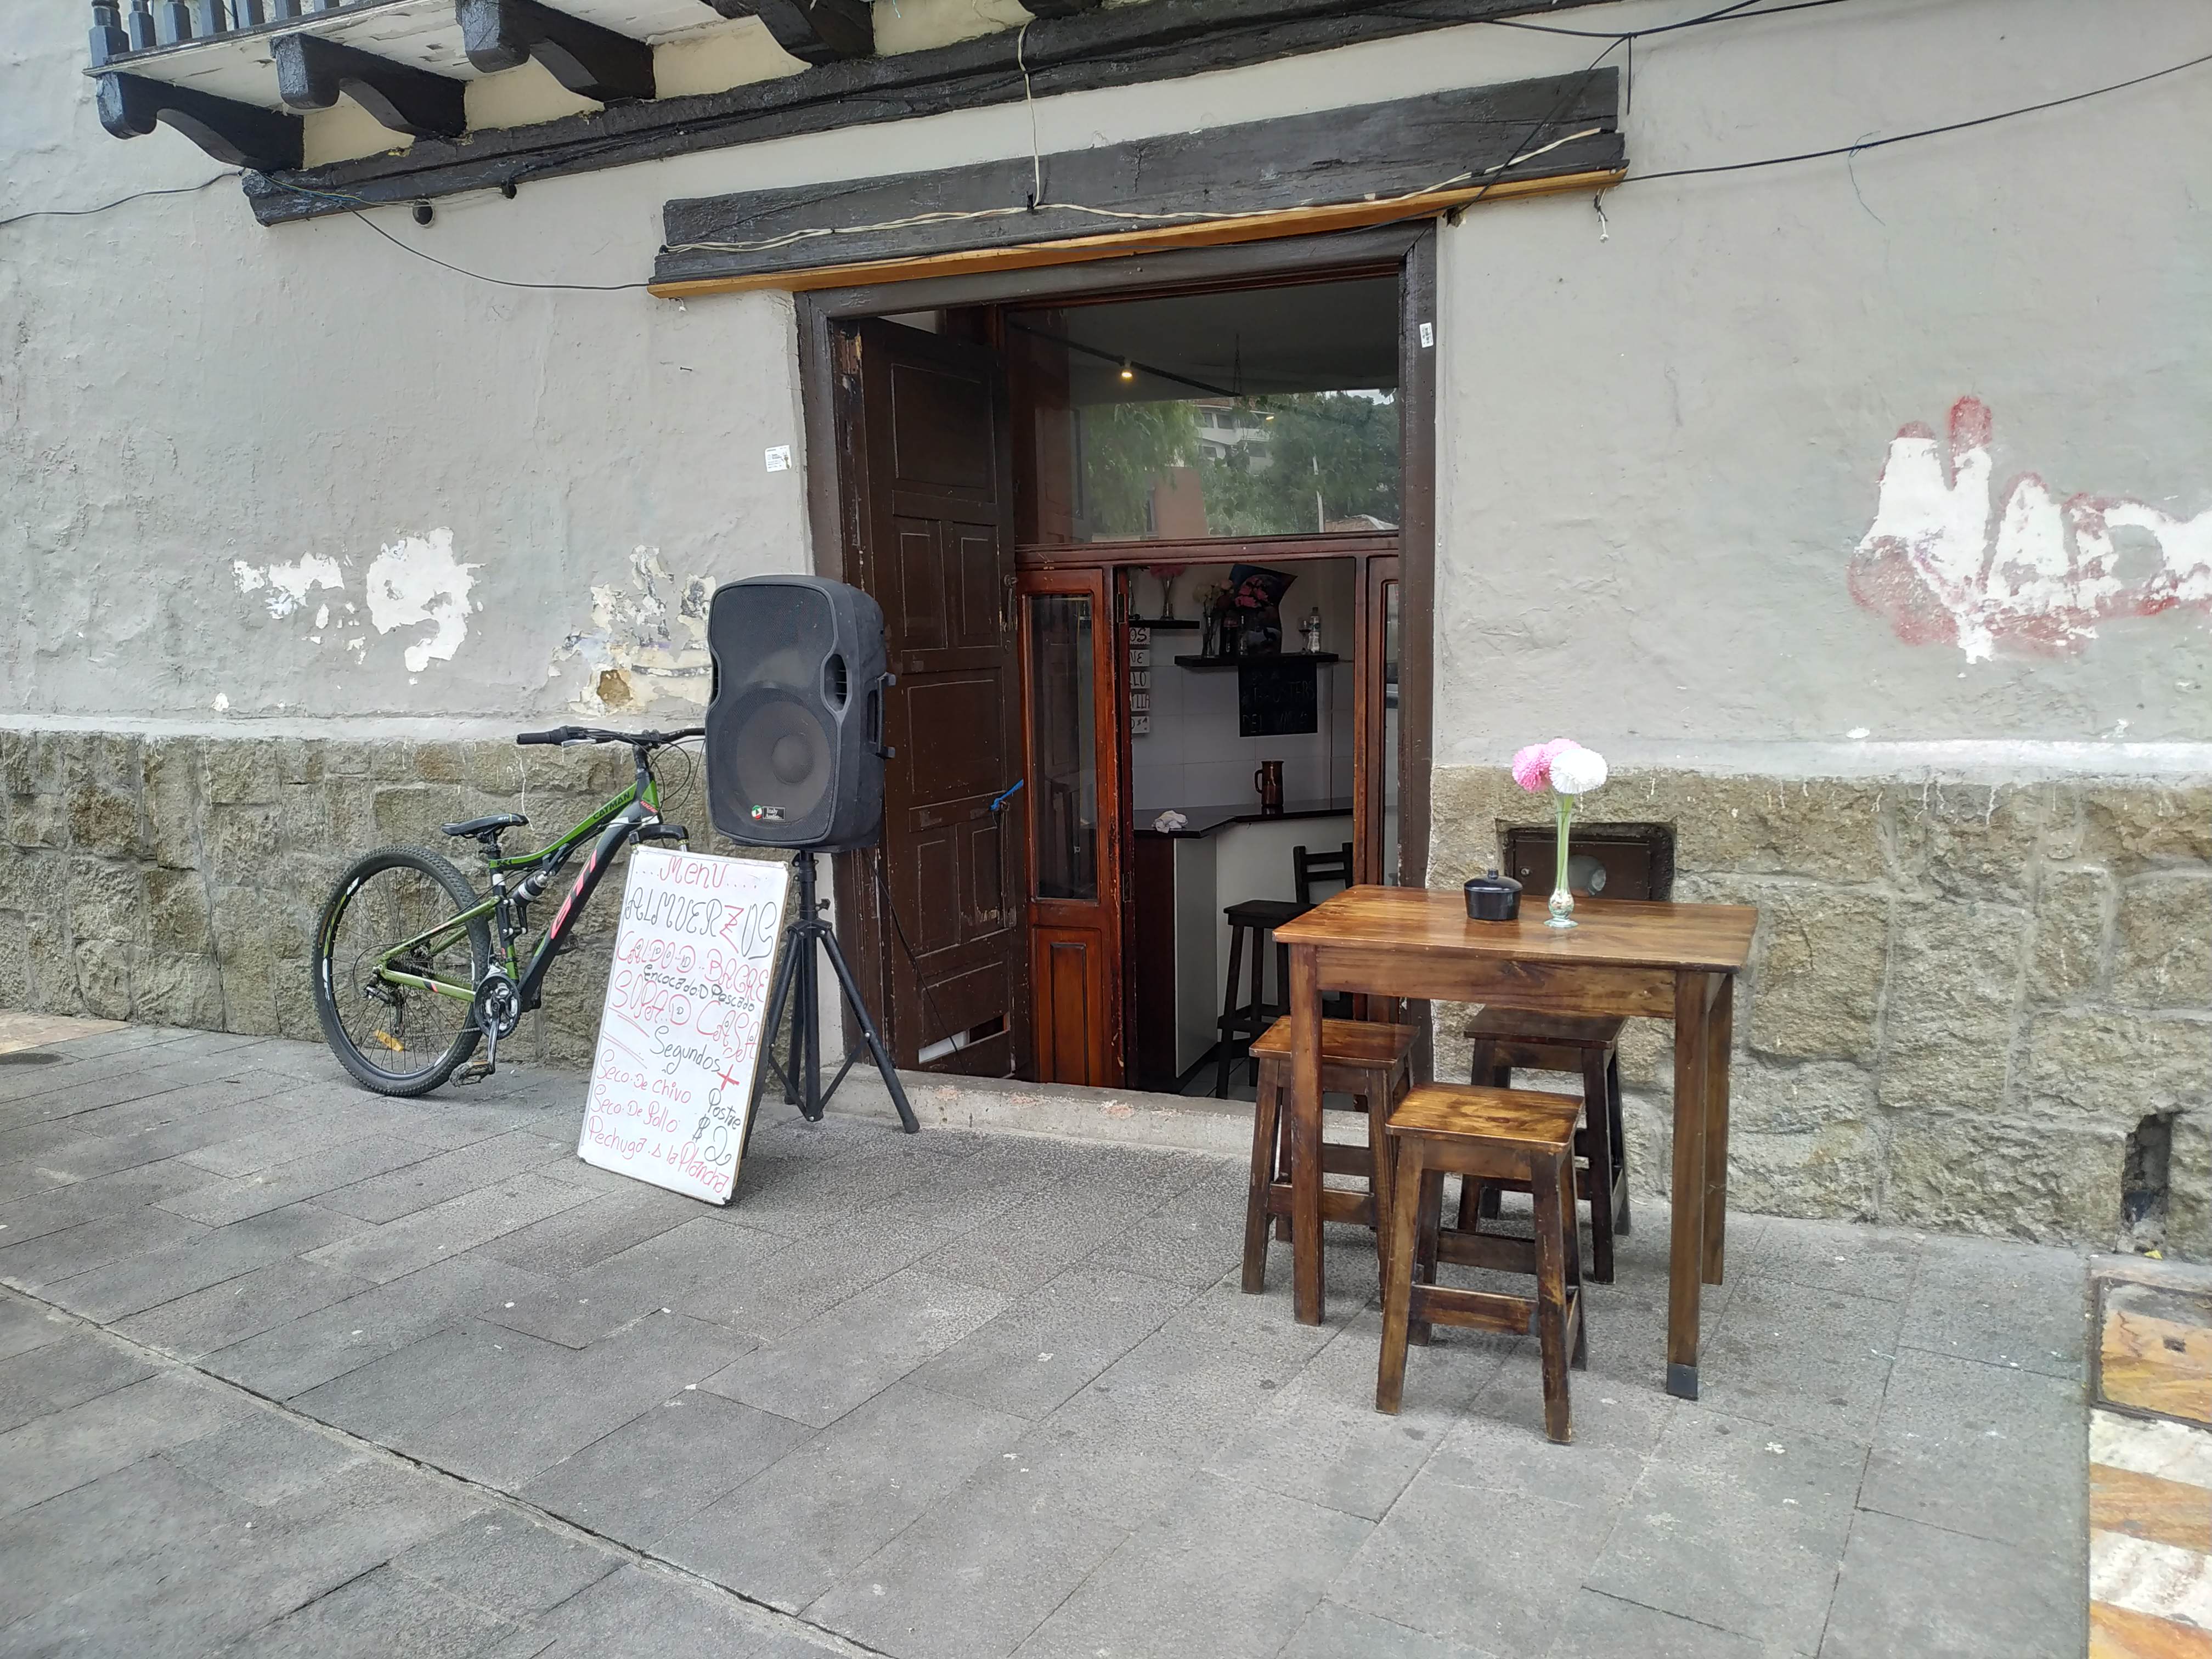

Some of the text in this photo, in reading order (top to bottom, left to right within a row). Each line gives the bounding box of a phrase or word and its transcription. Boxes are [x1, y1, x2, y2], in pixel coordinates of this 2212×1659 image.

[593, 792, 630, 820] CAYMAN
[767, 807, 778, 815] Italy
[624, 887, 777, 960] ALMUERZOS
[617, 931, 675, 969] CALDO
[704, 948, 768, 1002] BAGRE
[612, 969, 669, 1024] SOPA
[697, 1000, 759, 1062] CASA
[650, 1025, 721, 1075] Segundos
[634, 1073, 648, 1090] De
[652, 1079, 691, 1103] Chivo
[708, 1088, 741, 1130] Postre
[627, 1100, 643, 1116] De
[644, 1101, 678, 1132] Pollo
[589, 1115, 647, 1160] Pechuga
[667, 1144, 678, 1165] la
[678, 1141, 730, 1194] Plancha
